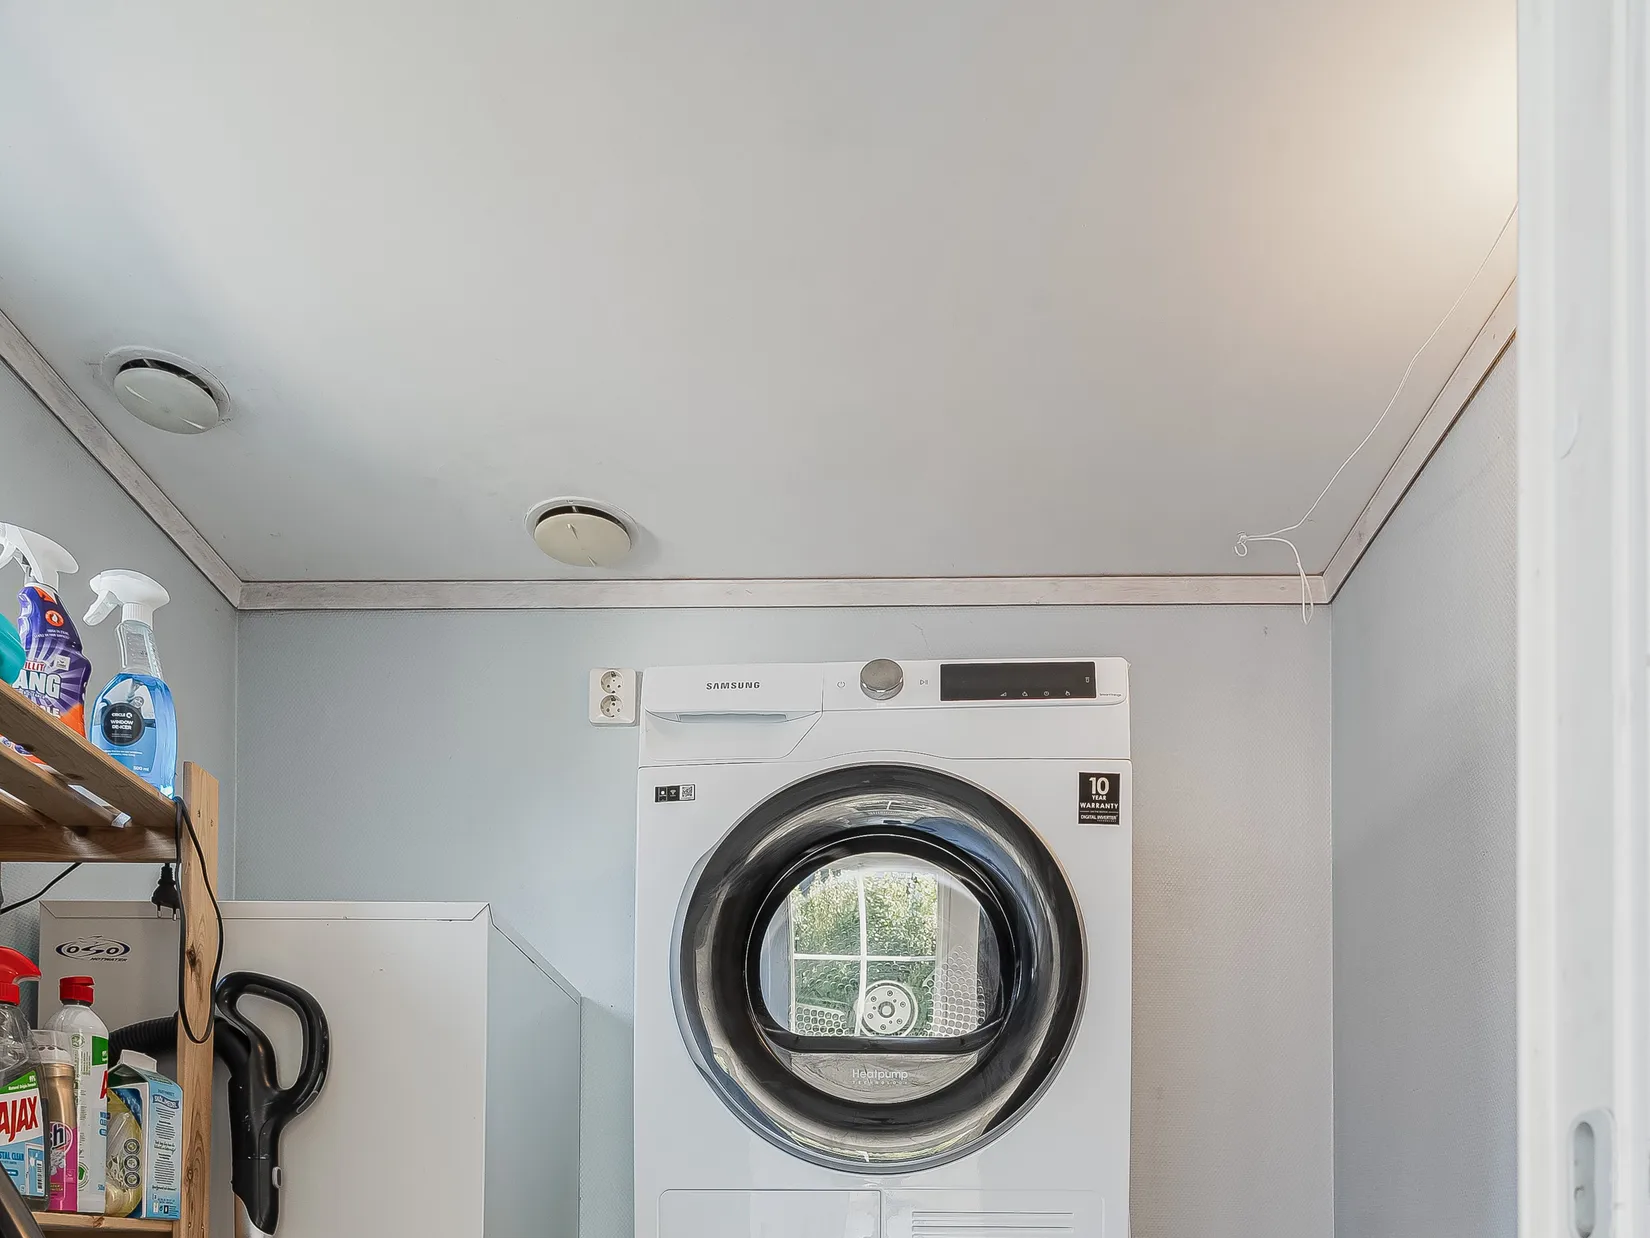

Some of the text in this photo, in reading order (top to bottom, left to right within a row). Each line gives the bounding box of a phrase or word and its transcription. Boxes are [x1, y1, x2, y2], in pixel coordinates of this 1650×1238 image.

[24, 661, 46, 672] ILLIT
[12, 669, 62, 699] ANG
[705, 682, 761, 690] SAMSUNG
[1088, 777, 1110, 795] 10
[1079, 802, 1119, 810] WARRANTY
[852, 1069, 909, 1081] Heatpump
[0, 1096, 39, 1142] AJAX
